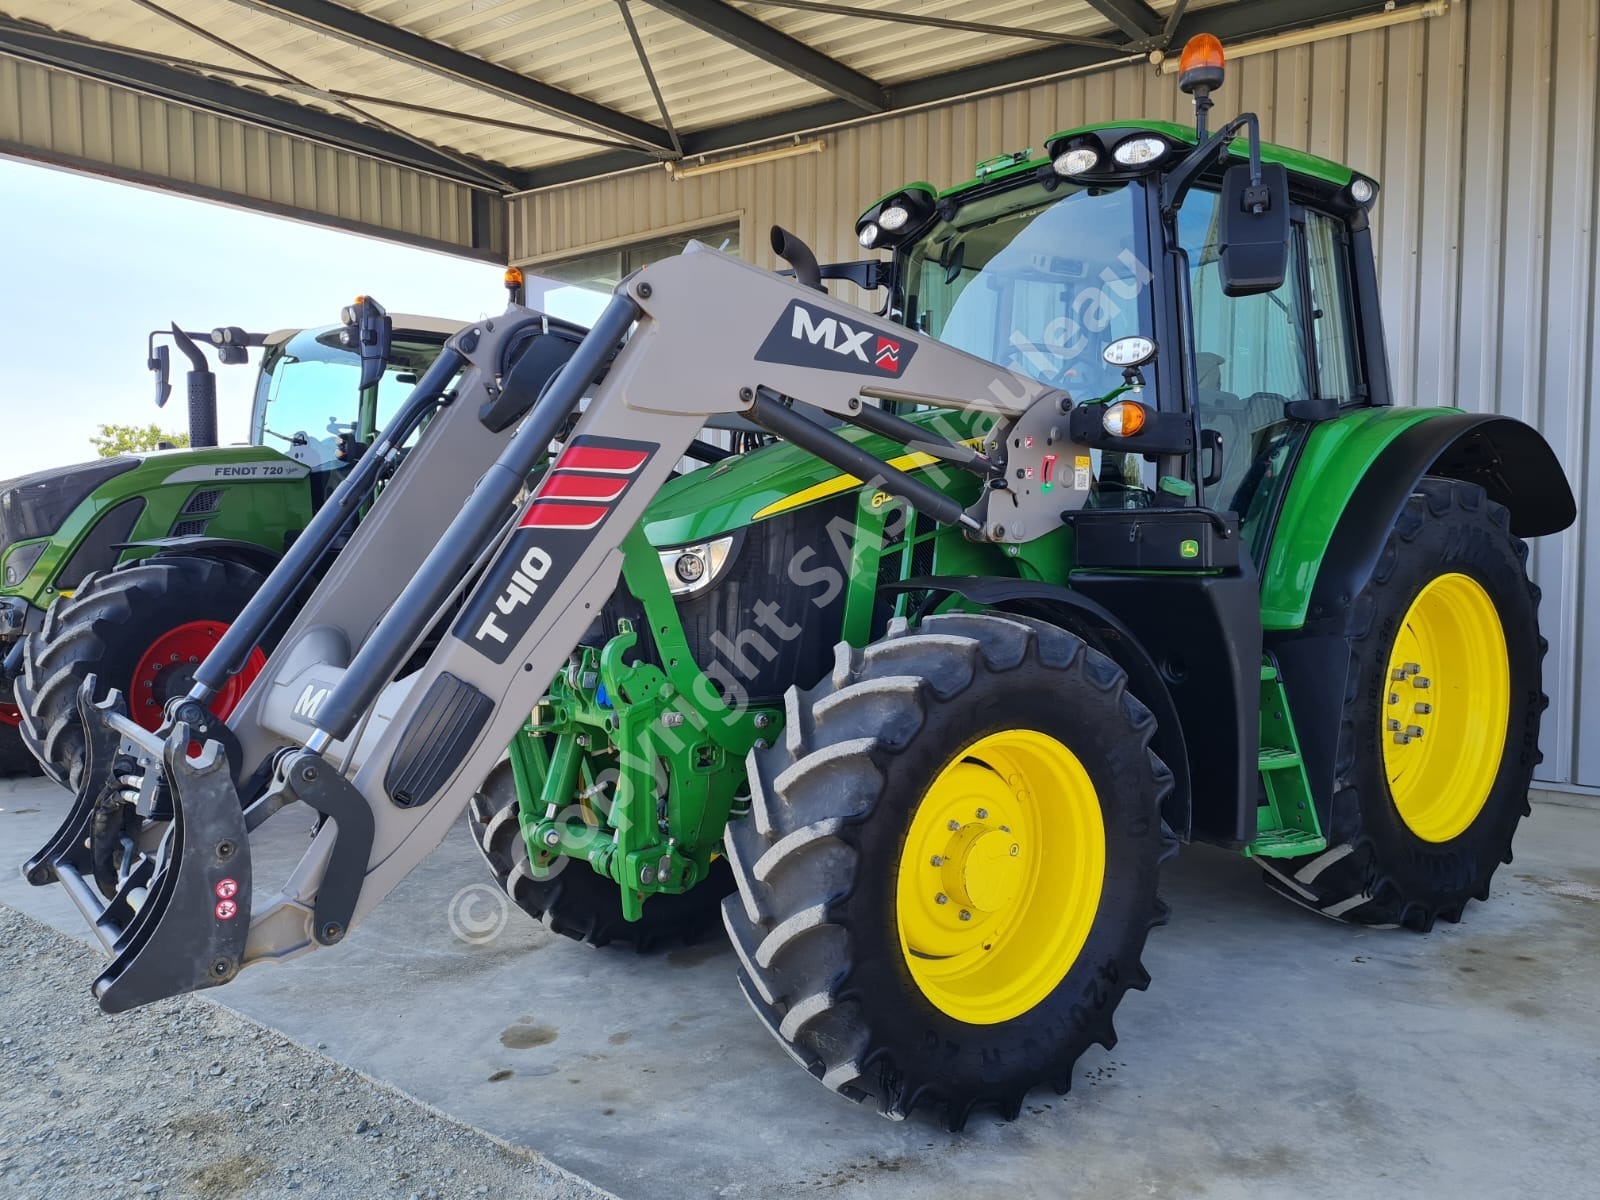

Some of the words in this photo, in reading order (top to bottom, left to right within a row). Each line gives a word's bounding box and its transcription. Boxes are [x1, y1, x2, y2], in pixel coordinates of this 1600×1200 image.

[791, 305, 874, 363] MX
[214, 467, 258, 476] FENDT
[263, 466, 284, 475] 720
[294, 684, 331, 718] M
